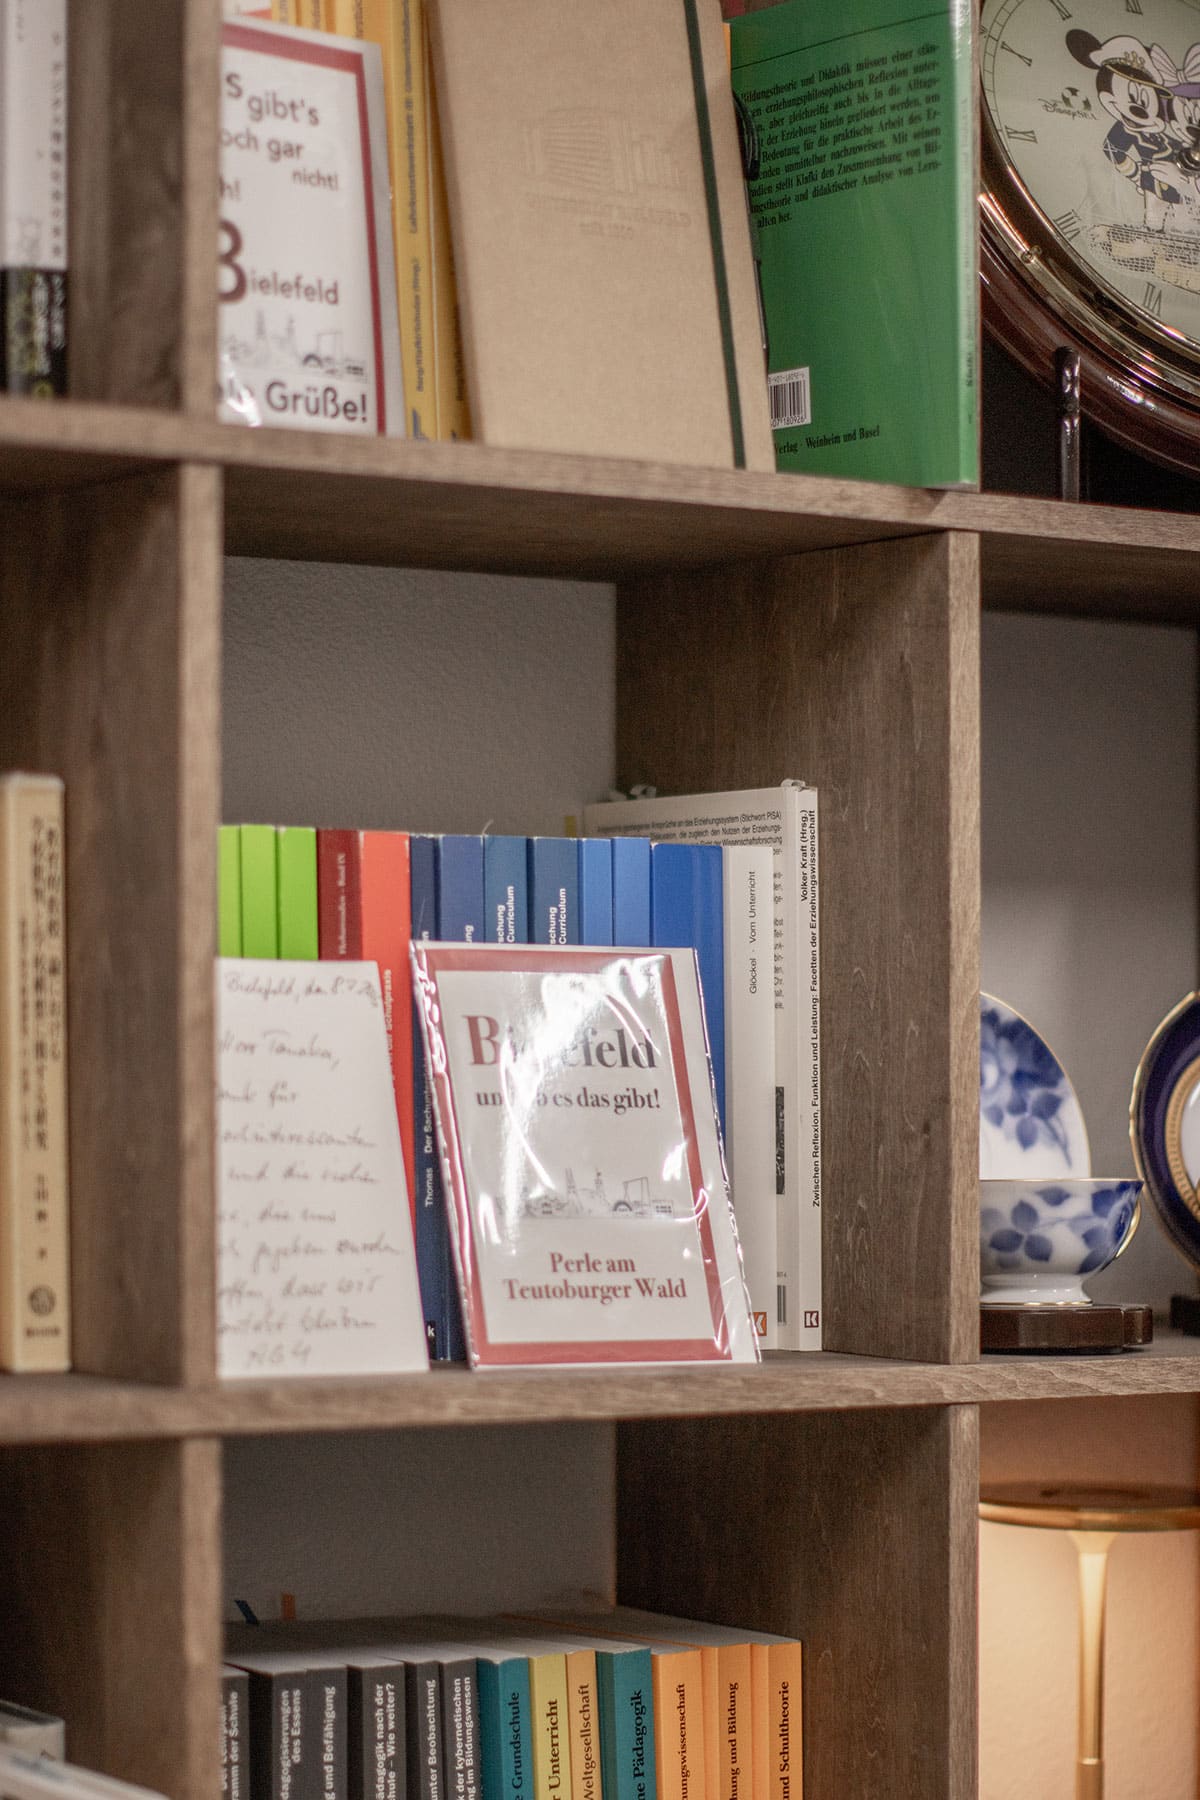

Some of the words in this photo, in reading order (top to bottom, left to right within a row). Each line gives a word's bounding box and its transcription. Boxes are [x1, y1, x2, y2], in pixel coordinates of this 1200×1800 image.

[248, 91, 319, 126] gibt's
[221, 128, 259, 151] och
[267, 139, 304, 162] gar
[293, 168, 339, 191] nicht!
[266, 379, 367, 423] Grüße!
[808, 809, 818, 929] Erziehungswissenschaft
[507, 886, 517, 942] Curriculum
[558, 887, 568, 944] Curriculum
[749, 870, 757, 919] Unterricht
[547, 906, 558, 945] schung
[749, 922, 757, 946] Vom
[808, 931, 817, 948] der
[809, 949, 818, 992] Facetten
[809, 995, 819, 1041] Leistung:
[810, 1042, 818, 1061] und
[552, 1091, 574, 1108] es
[577, 1086, 611, 1109] das
[614, 1087, 661, 1116] gibt!
[810, 1063, 819, 1107] Funktion
[425, 1134, 434, 1155] Der
[811, 1109, 820, 1159] Reflexion,
[425, 1167, 434, 1208] Thomas
[811, 1162, 821, 1208] Zwischen
[550, 1252, 602, 1274] Perle
[606, 1258, 636, 1273] am
[503, 1277, 632, 1306] Teutoburger
[638, 1277, 688, 1300] Wald
[230, 1691, 239, 1737] Schule
[291, 1689, 301, 1742] Essens
[374, 1684, 384, 1706] der
[385, 1682, 396, 1730] weiter?
[725, 1682, 739, 1735] Bildung
[323, 1685, 336, 1763] Befähigung
[374, 1707, 384, 1740] nach
[425, 1679, 437, 1765] Beobachtung
[453, 1678, 465, 1770] kybernetischen
[463, 1676, 475, 1768] Bildungswesen
[509, 1692, 522, 1790] Grundschule
[630, 1689, 646, 1778] Pädagogik
[675, 1683, 690, 1800] ungswissenschaft
[778, 1681, 791, 1773] Schultheorie
[230, 1740, 239, 1762] der
[280, 1690, 290, 1800] dagogisierungen
[291, 1744, 301, 1764] des
[386, 1731, 395, 1758] Wie
[545, 1699, 561, 1790] Unterricht
[727, 1738, 737, 1765] und
[324, 1765, 335, 1789] und
[374, 1742, 386, 1800] ädagogik
[386, 1771, 397, 1800] chule
[455, 1771, 465, 1793] der
[466, 1769, 474, 1785] im
[727, 1766, 740, 1800] hung
